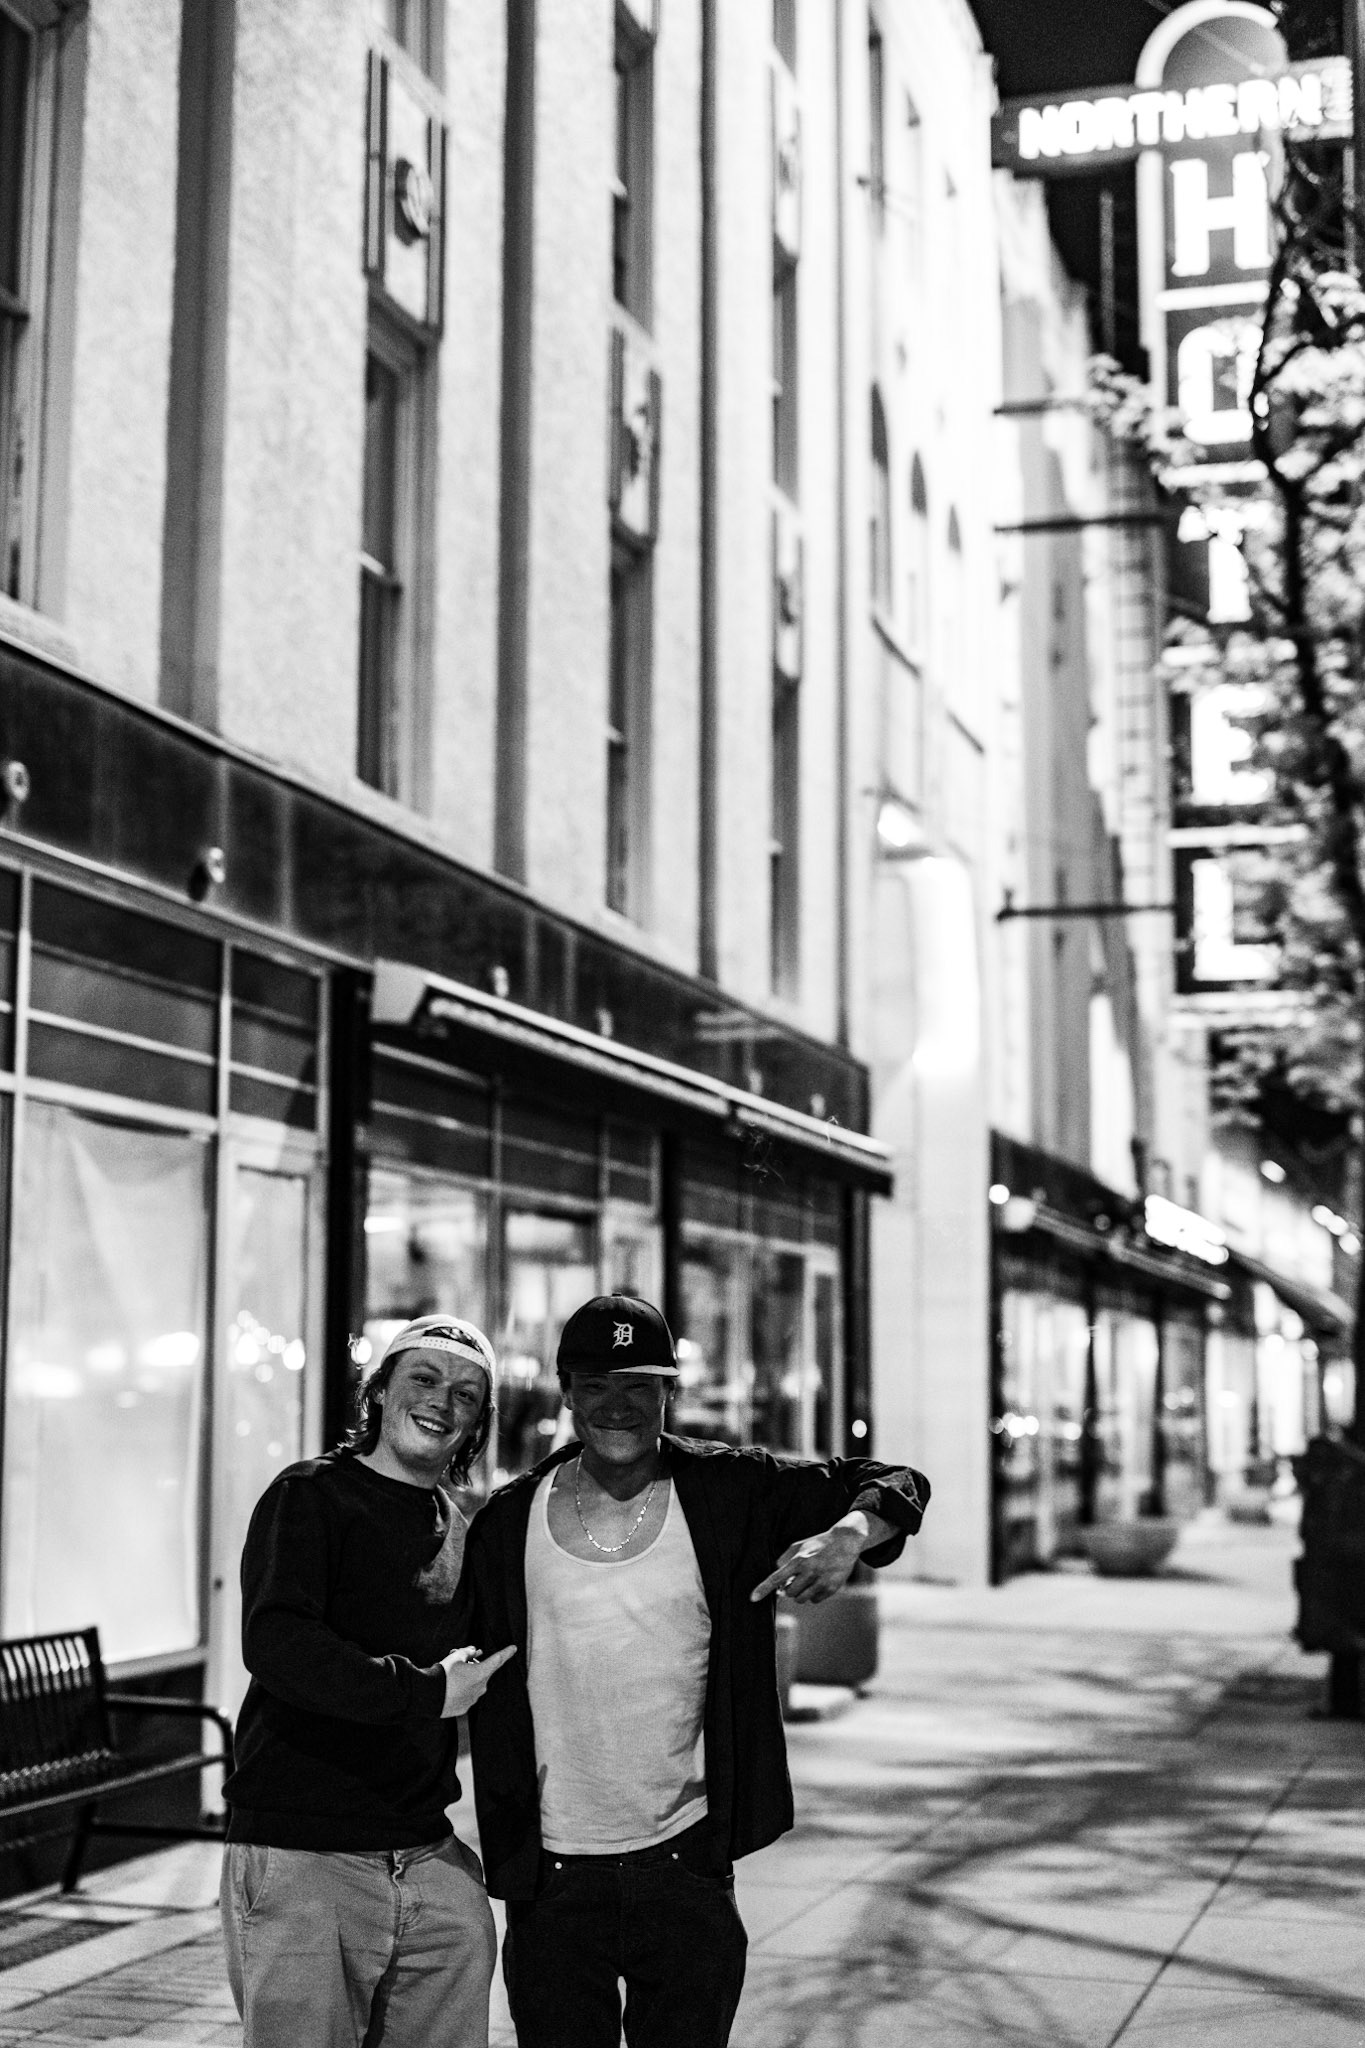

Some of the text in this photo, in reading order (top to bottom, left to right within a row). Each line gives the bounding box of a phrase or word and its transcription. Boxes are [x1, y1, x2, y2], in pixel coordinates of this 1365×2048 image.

[1018, 73, 1323, 160] NORTHERN
[1170, 151, 1281, 980] HOTEL
[612, 1320, 635, 1350] D
